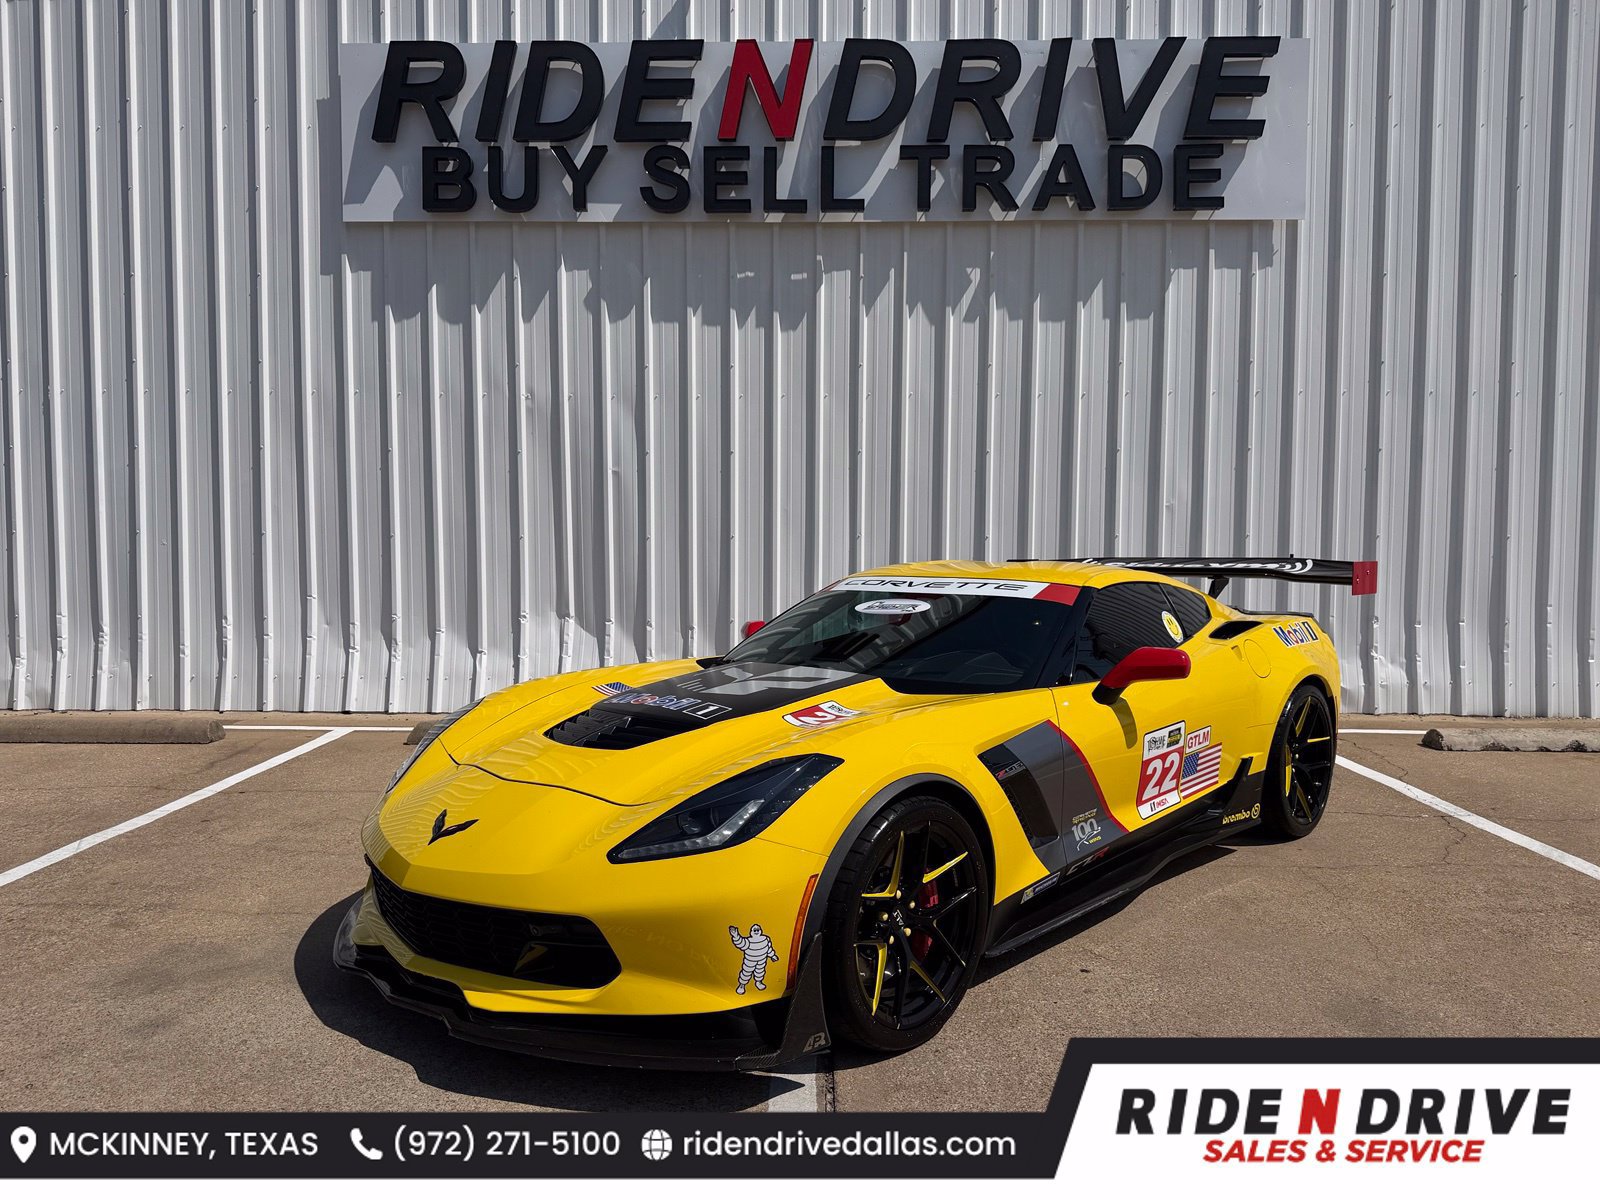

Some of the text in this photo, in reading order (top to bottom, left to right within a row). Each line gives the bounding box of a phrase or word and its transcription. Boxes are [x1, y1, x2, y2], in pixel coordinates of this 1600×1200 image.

[421, 143, 1225, 214] BUY SELL TRADE
[845, 579, 1028, 592] CORVETTE
[1272, 622, 1311, 647] Mobil
[1187, 730, 1210, 750] GTLM
[1142, 752, 1180, 801] 22
[1222, 809, 1251, 825] brembo
[1071, 818, 1099, 841] 100
